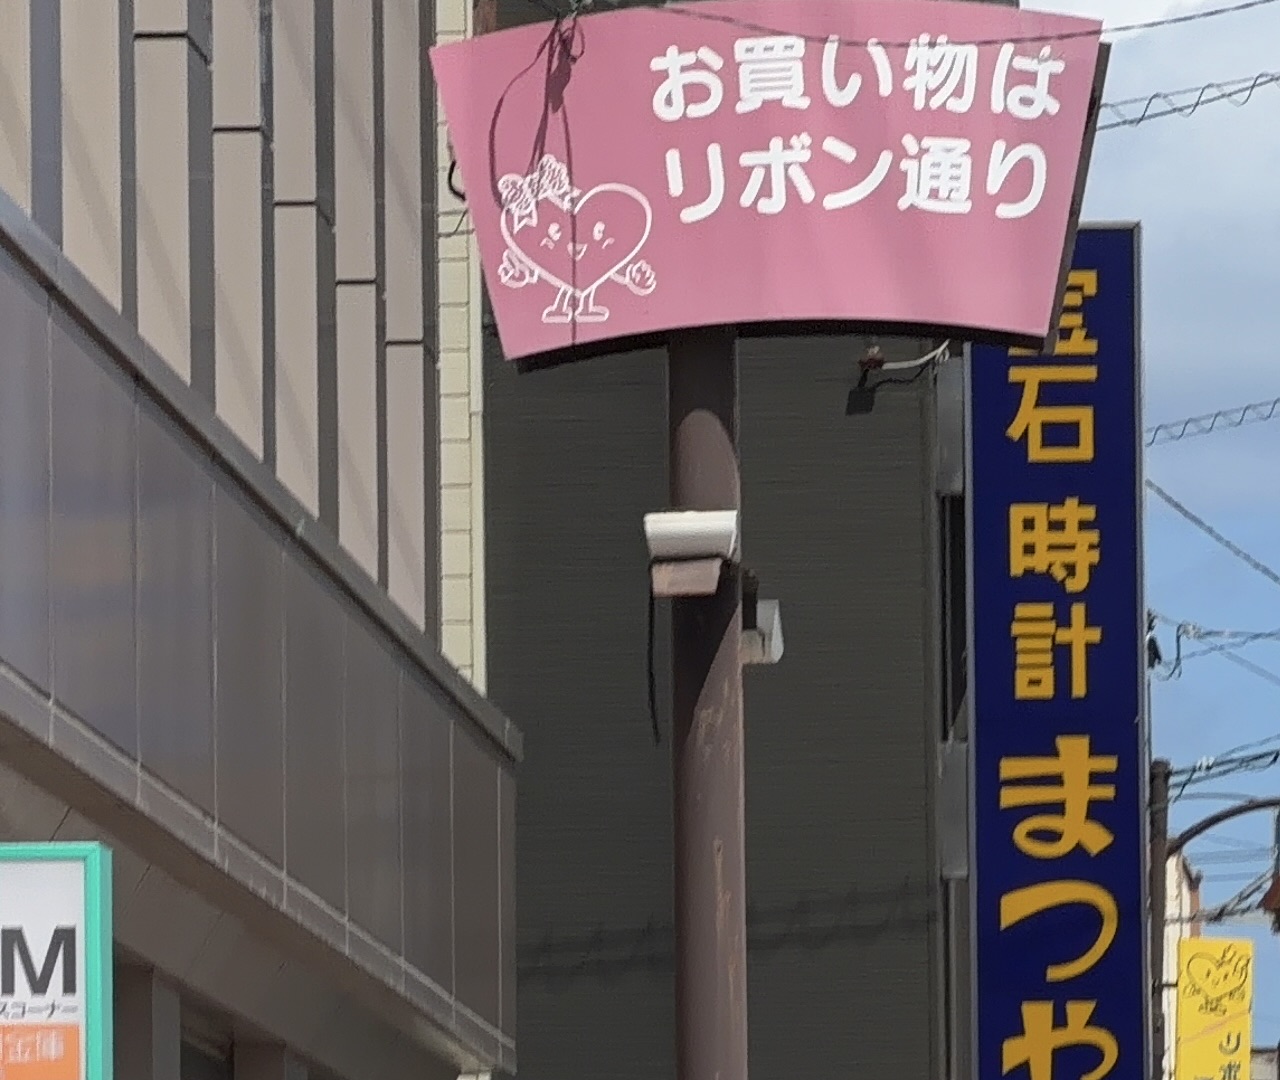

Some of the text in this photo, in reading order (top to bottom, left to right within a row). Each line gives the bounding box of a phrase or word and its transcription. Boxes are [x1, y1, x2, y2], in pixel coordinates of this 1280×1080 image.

[650, 33, 1066, 122] お買い物は
[665, 132, 1047, 224] リボン通り
[0, 1028, 66, 1063] 金庫
